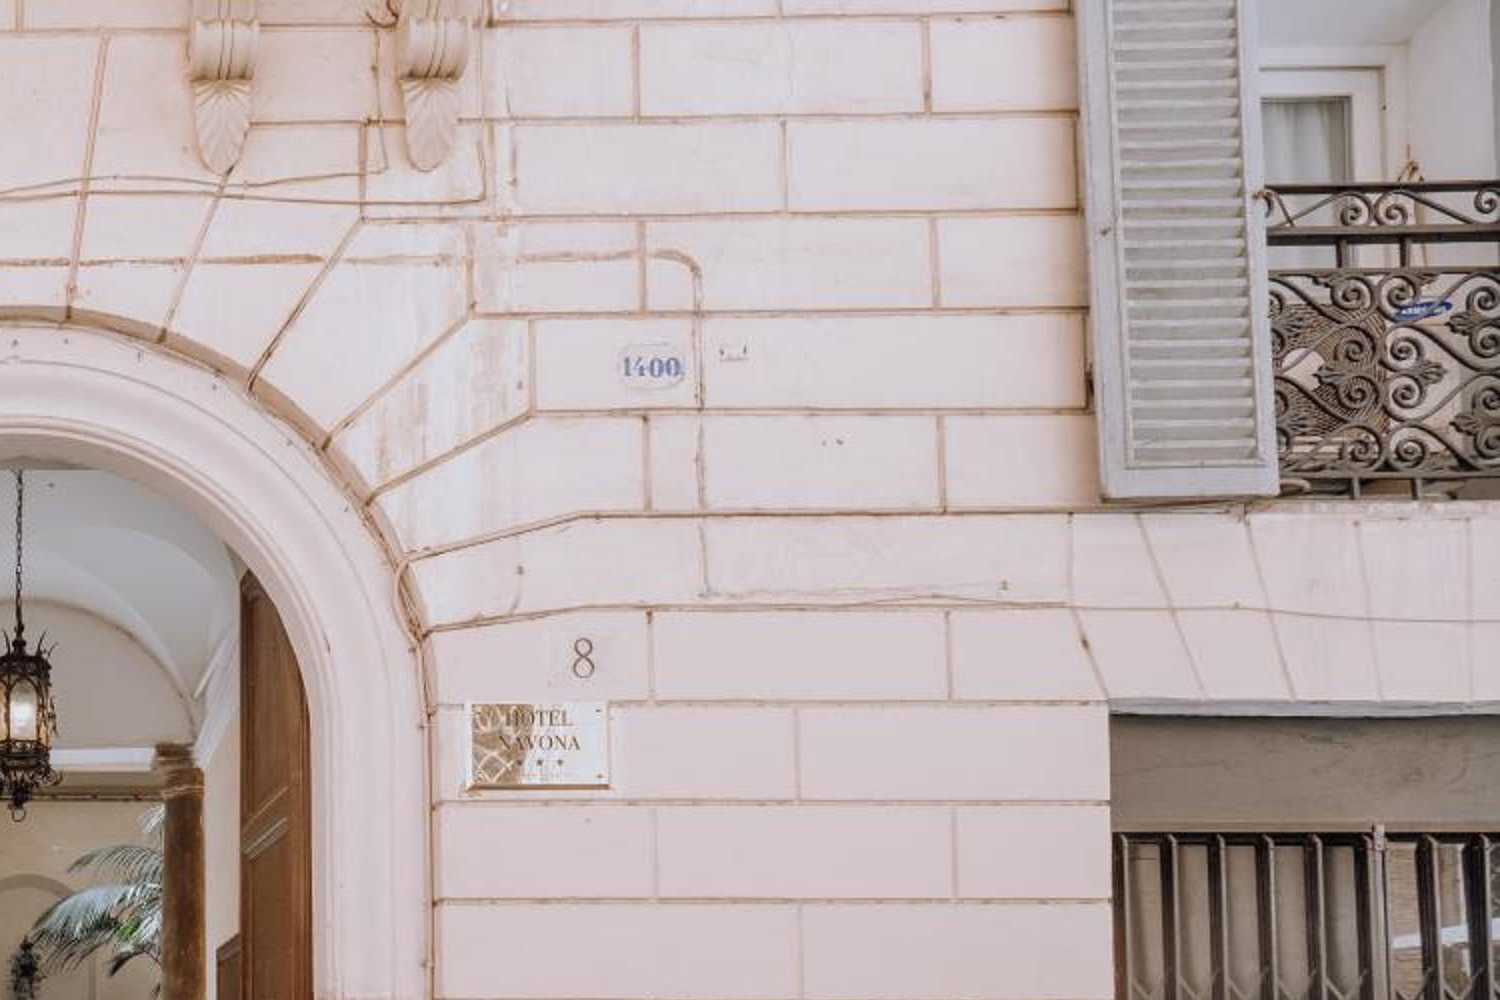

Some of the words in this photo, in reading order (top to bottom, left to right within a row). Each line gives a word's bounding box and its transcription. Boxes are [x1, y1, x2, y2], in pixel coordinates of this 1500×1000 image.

[573, 637, 595, 679] 8
[504, 708, 574, 727] HOTEL
[499, 735, 581, 751] NAVONA
